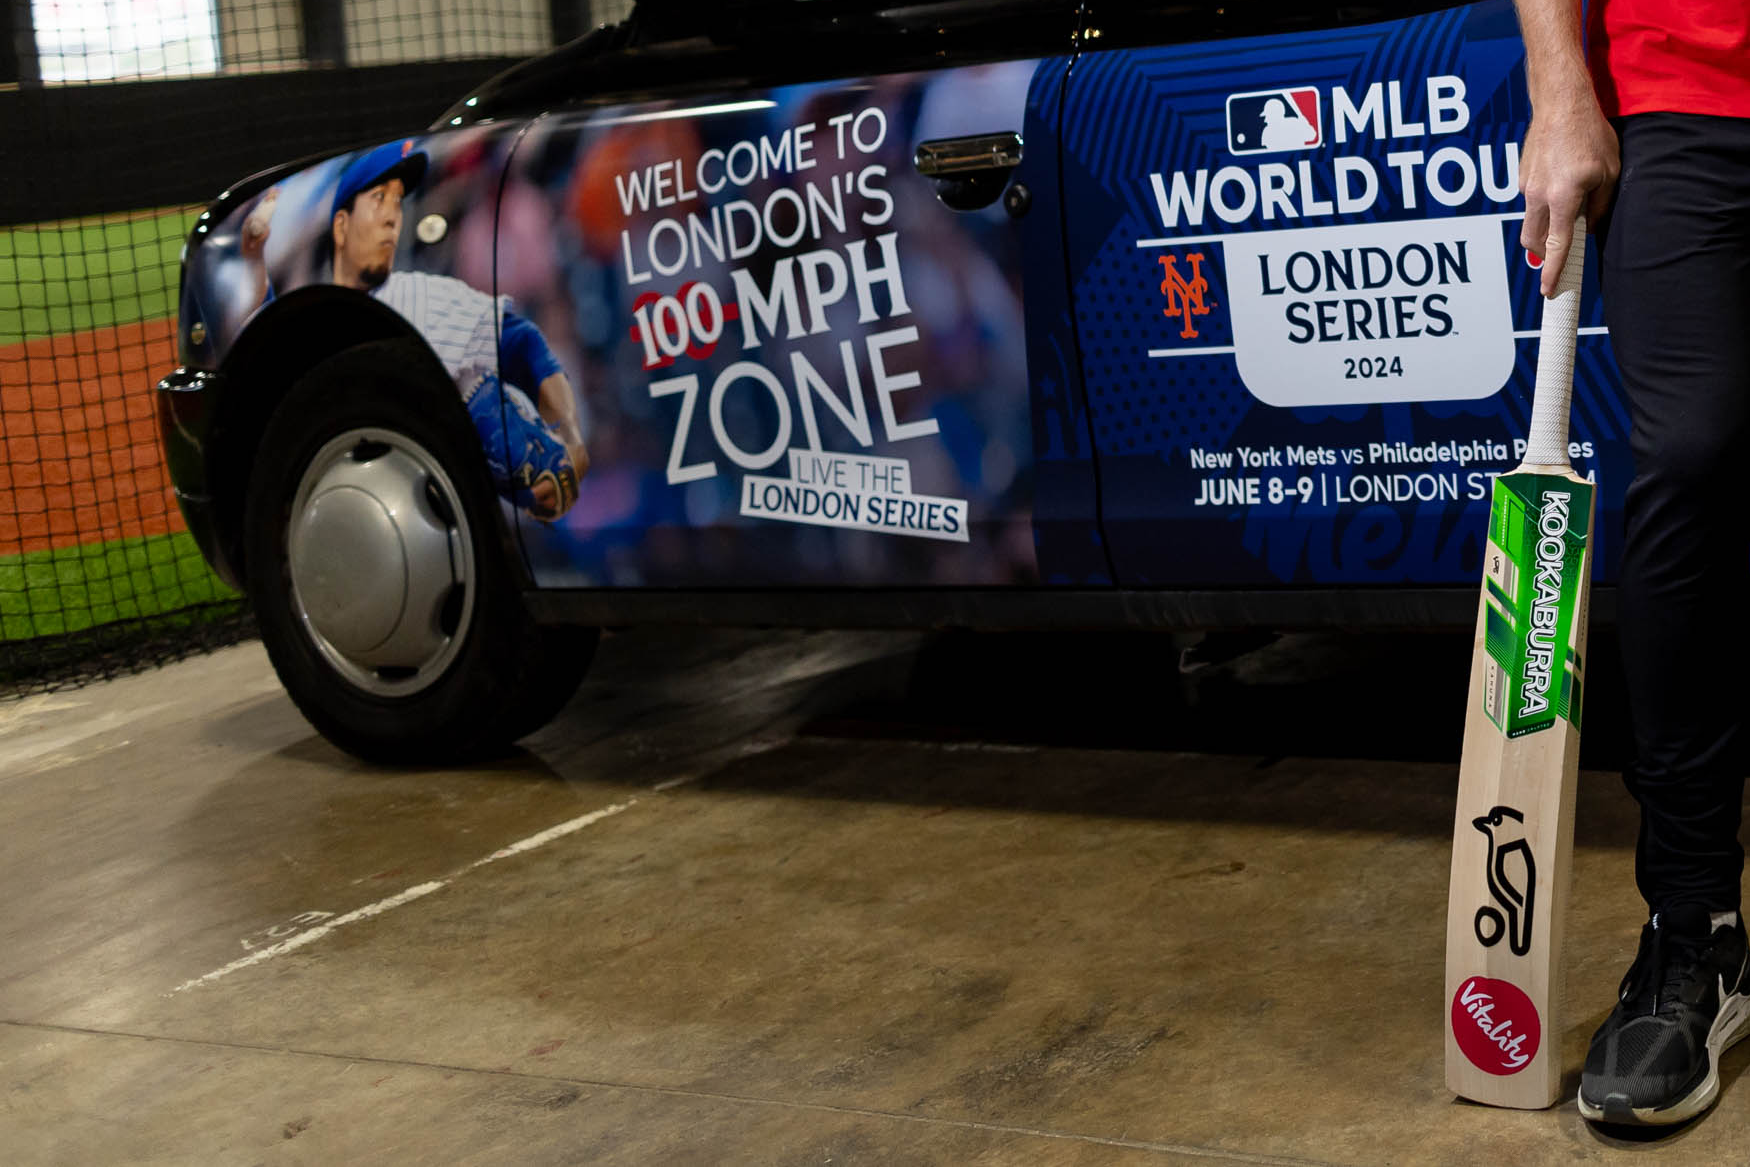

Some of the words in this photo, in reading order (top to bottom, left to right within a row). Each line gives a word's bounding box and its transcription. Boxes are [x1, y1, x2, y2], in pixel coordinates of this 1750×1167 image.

[1333, 75, 1470, 143] MLB
[615, 122, 817, 216] WELCOME
[828, 106, 888, 160] TO
[1150, 154, 1380, 228] WORLD
[1387, 142, 1520, 209] TOU
[622, 165, 894, 285] LONDON'S
[730, 231, 912, 350] MPH
[1258, 240, 1472, 296] LONDON
[1284, 293, 1454, 344] SERIES
[1343, 355, 1404, 379] 2024
[648, 325, 940, 486] ZONE
[798, 456, 846, 489] LIVE
[856, 462, 906, 495] THE
[1190, 448, 1234, 469] New
[1237, 446, 1283, 467] York
[1287, 445, 1336, 466] Mets
[1341, 449, 1364, 464] vs
[1370, 440, 1508, 468] Philadelphia
[748, 482, 862, 522] LONDON
[866, 497, 960, 534] SERIES
[1195, 478, 1260, 506] JUNE
[1268, 477, 1313, 505] 8-9
[1336, 473, 1458, 503] LONDON
[1518, 491, 1571, 719] KOOKABURRA
[1459, 981, 1530, 1068] Vitality
